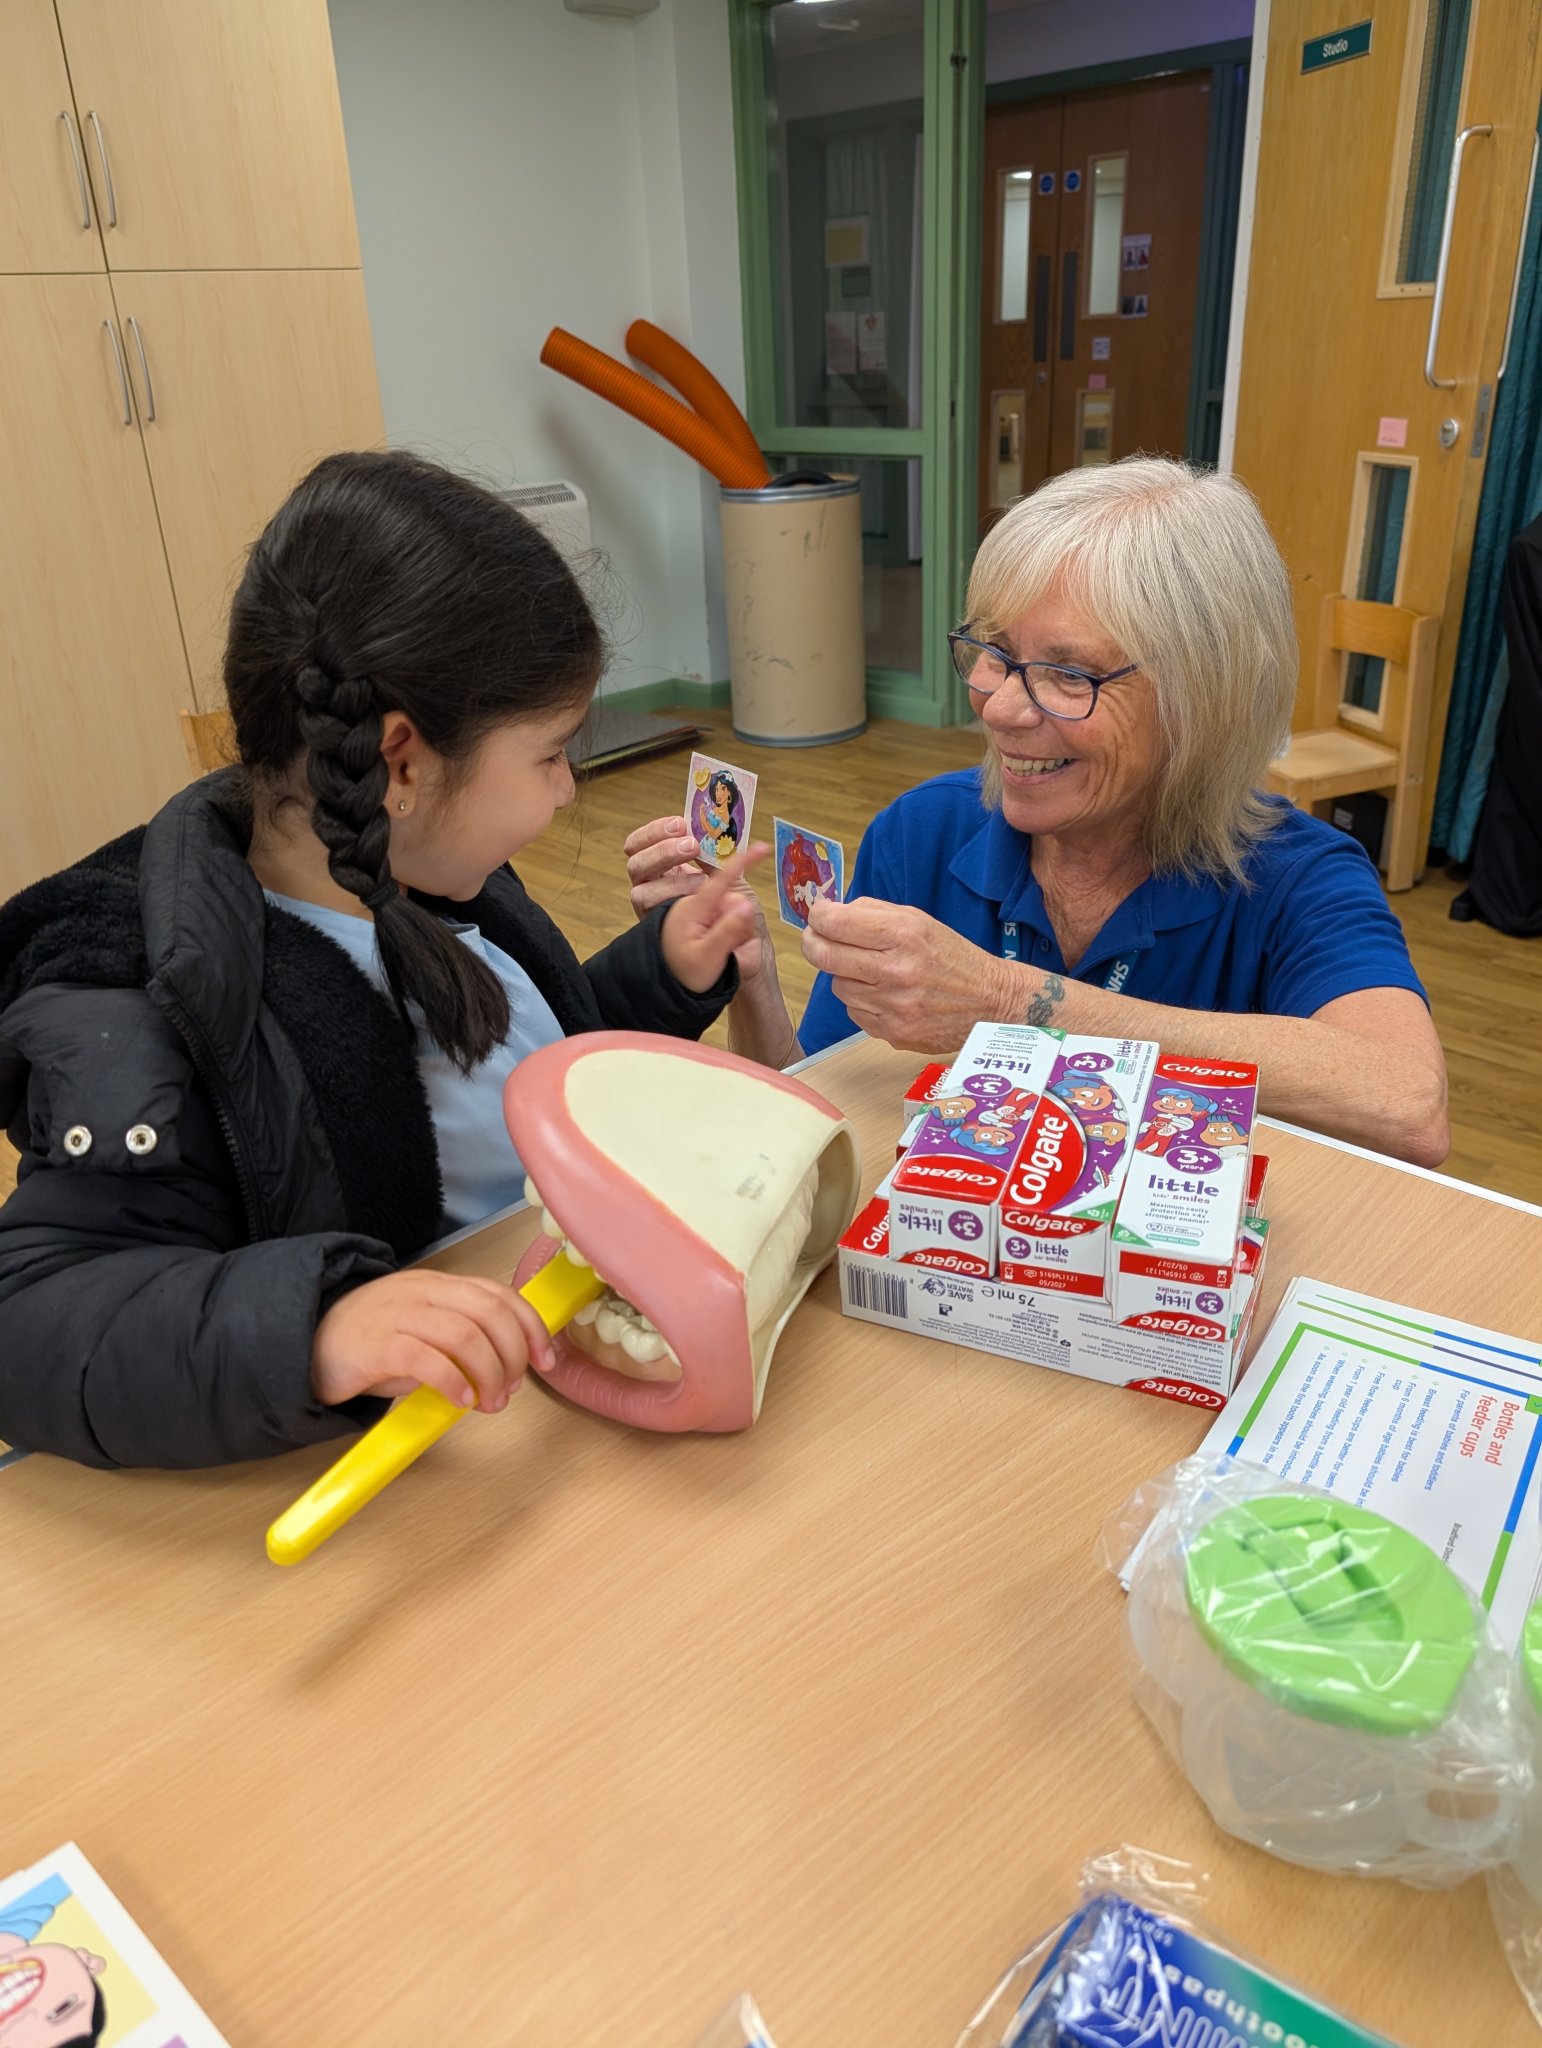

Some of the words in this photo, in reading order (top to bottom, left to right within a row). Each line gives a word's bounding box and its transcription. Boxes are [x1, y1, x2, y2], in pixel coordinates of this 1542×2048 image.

[1322, 38, 1348, 58] Studio
[1105, 960, 1129, 993] NHS
[982, 1052, 1013, 1060] smiles
[1113, 1040, 1133, 1058] little
[973, 1058, 1032, 1074] little
[1074, 1055, 1098, 1069] 3+
[1162, 1062, 1248, 1080] Colgate
[970, 1080, 1002, 1094] 3+
[1010, 1116, 1068, 1205] Colgate
[1177, 1149, 1213, 1164] 3+
[1179, 1163, 1204, 1171] years
[905, 1165, 998, 1186] Colgate
[1148, 1174, 1220, 1198] little
[1172, 1194, 1211, 1204] smiles
[900, 1204, 928, 1214] smiles
[1144, 1210, 1176, 1221] stronger
[1149, 1201, 1184, 1211] Maximum
[1185, 1206, 1208, 1214] cavity
[1150, 1205, 1190, 1218] protection
[863, 1210, 890, 1250] Colg
[898, 1213, 942, 1235] little
[954, 1220, 976, 1238] 3+
[1004, 1211, 1084, 1233] Colgate
[1010, 1240, 1027, 1252] 3+
[1035, 1240, 1069, 1258] little
[914, 1252, 986, 1275] Colgate
[1046, 1256, 1068, 1264] smiles
[1158, 1260, 1188, 1270] 05/2027
[946, 1282, 974, 1294] WATER
[1038, 1280, 1066, 1288] 05/2027
[1157, 1286, 1180, 1295] smiles
[948, 1290, 974, 1302] SAVE
[998, 1289, 1015, 1300] ml
[1018, 1294, 1036, 1307] 75
[1155, 1293, 1190, 1310] little
[1200, 1300, 1218, 1312] 3+
[1139, 1316, 1222, 1340] Colgate
[1316, 1352, 1326, 1361] As
[1308, 1360, 1321, 1375] soon
[1331, 1358, 1346, 1375] When
[1351, 1364, 1365, 1381] From
[1181, 1372, 1220, 1386] INSTRUCTIONS
[1304, 1374, 1314, 1383] as
[1372, 1371, 1386, 1385] Free
[1390, 1378, 1404, 1391] cup
[1144, 1380, 1222, 1407] Colgate
[1299, 1382, 1311, 1393] the
[1341, 1384, 1355, 1398] year
[1366, 1384, 1380, 1398] flow
[1402, 1381, 1416, 1398] From
[1459, 1389, 1470, 1400] For
[1292, 1391, 1306, 1405] first
[1337, 1397, 1349, 1408] old
[1422, 1388, 1436, 1408] Breast
[1284, 1404, 1299, 1421] tooth
[1308, 1399, 1326, 1420] babies
[1357, 1397, 1374, 1417] feeder
[1390, 1401, 1407, 1425] months
[1448, 1398, 1465, 1423] parents
[1467, 1392, 1499, 1432] feeder
[1325, 1407, 1345, 1431] feeding
[1348, 1415, 1364, 1432] cups
[1411, 1406, 1429, 1430] feeding
[1492, 1399, 1520, 1442] Bottles
[1269, 1419, 1290, 1445] appears
[1297, 1419, 1315, 1441] should
[1387, 1424, 1398, 1433] of
[1409, 1429, 1420, 1437] is
[1447, 1422, 1457, 1431] of
[1319, 1429, 1333, 1446] from
[1345, 1431, 1357, 1443] are
[1380, 1430, 1393, 1443] age
[1404, 1435, 1417, 1451] best
[1439, 1429, 1454, 1451] babies
[1454, 1428, 1481, 1458] cups
[1267, 1444, 1277, 1453] in
[1293, 1440, 1304, 1450] be
[1335, 1442, 1352, 1461] better
[1483, 1440, 1507, 1466] and
[1261, 1452, 1274, 1464] the
[1306, 1449, 1324, 1470] bottle
[1372, 1443, 1389, 1465] babies
[1399, 1450, 1411, 1461] for
[1434, 1450, 1446, 1463] and
[1277, 1448, 1300, 1479] introduc
[1331, 1460, 1343, 1471] for
[1390, 1459, 1407, 1483] babies
[1323, 1471, 1339, 1489] teeth
[1362, 1464, 1380, 1488] should
[1423, 1463, 1441, 1491] toddlers
[1358, 1487, 1370, 1498] be
